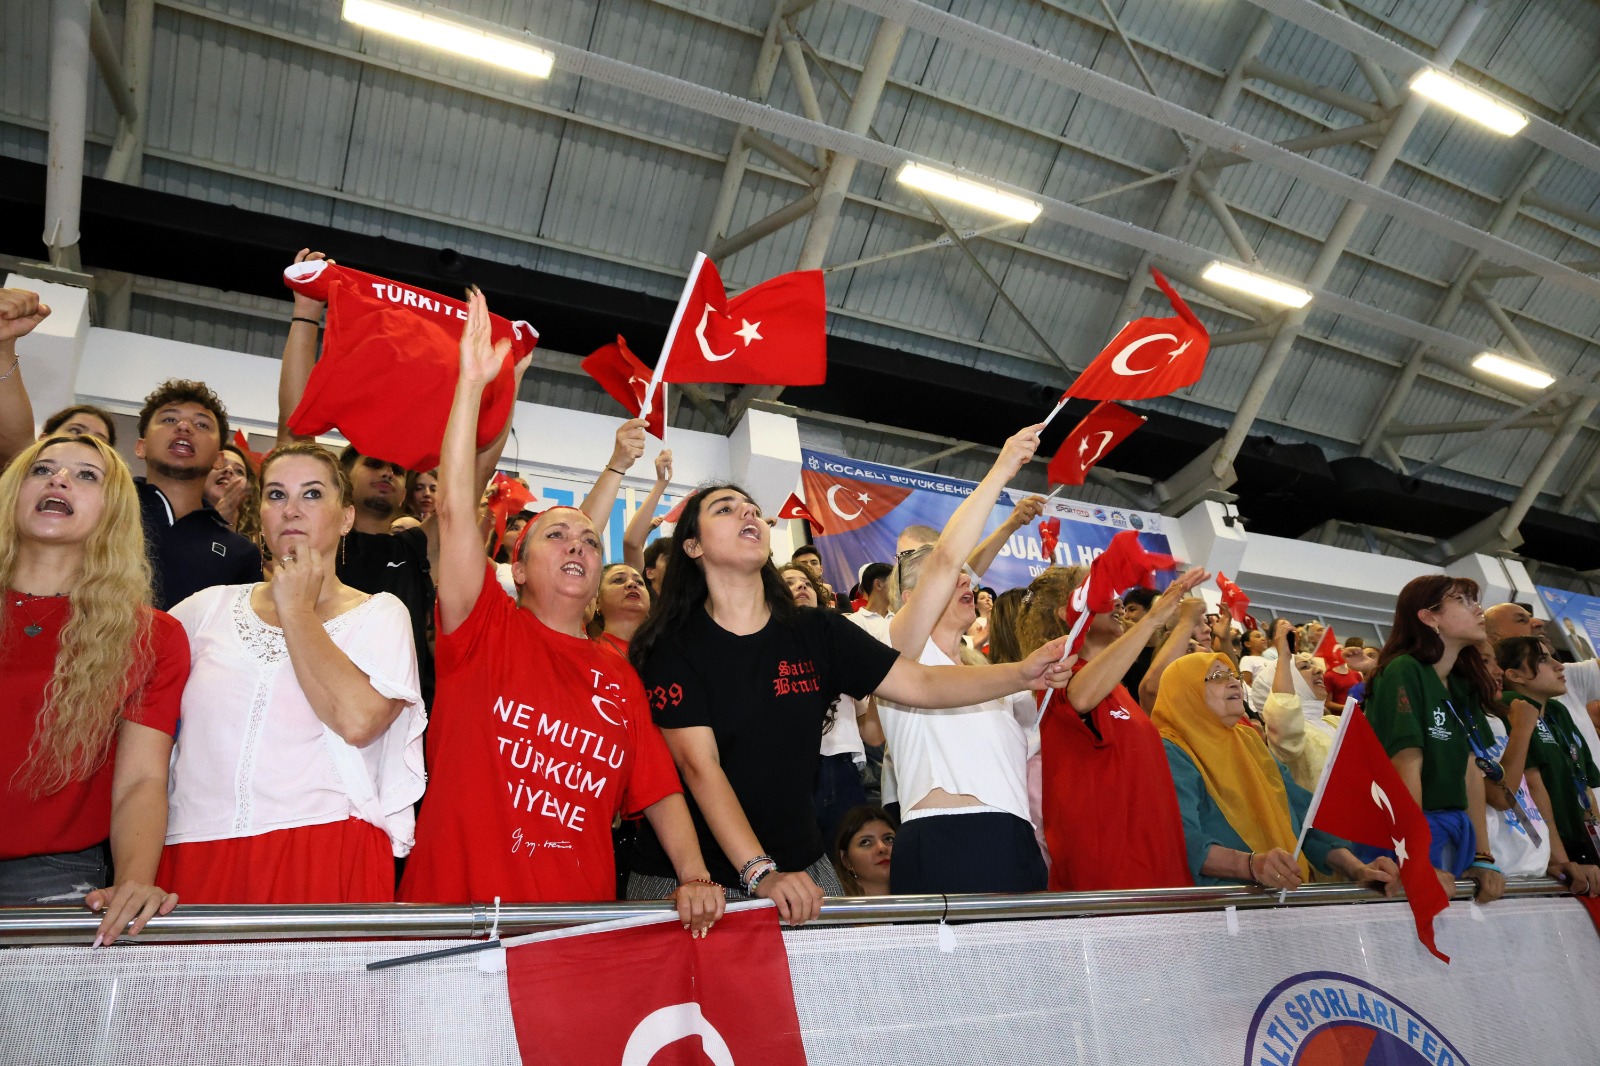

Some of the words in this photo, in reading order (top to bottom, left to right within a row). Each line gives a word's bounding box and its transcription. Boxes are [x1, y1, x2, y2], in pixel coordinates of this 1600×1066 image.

[998, 534, 1074, 566] SUATI
[493, 695, 535, 730] NE
[536, 712, 625, 770] MUTLU
[497, 735, 607, 799] TÜRKÜM
[507, 778, 586, 832] İYENE
[1284, 987, 1399, 1034] SPORLARI
